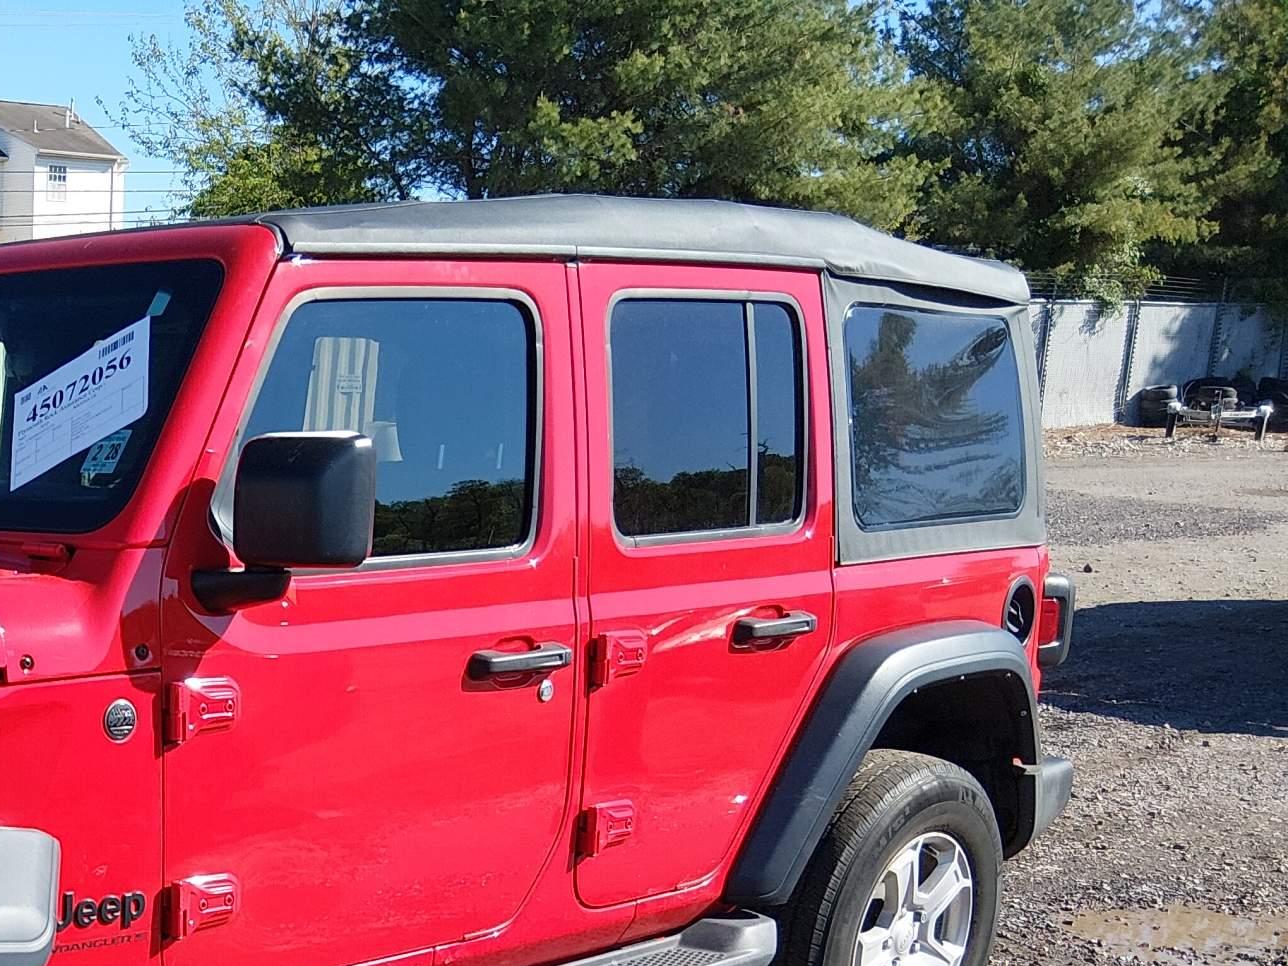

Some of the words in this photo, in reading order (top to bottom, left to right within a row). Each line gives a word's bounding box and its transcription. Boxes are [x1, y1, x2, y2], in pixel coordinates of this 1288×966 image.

[26, 349, 131, 422] 45072056
[103, 442, 122, 461] 28
[56, 890, 146, 933] Jeep
